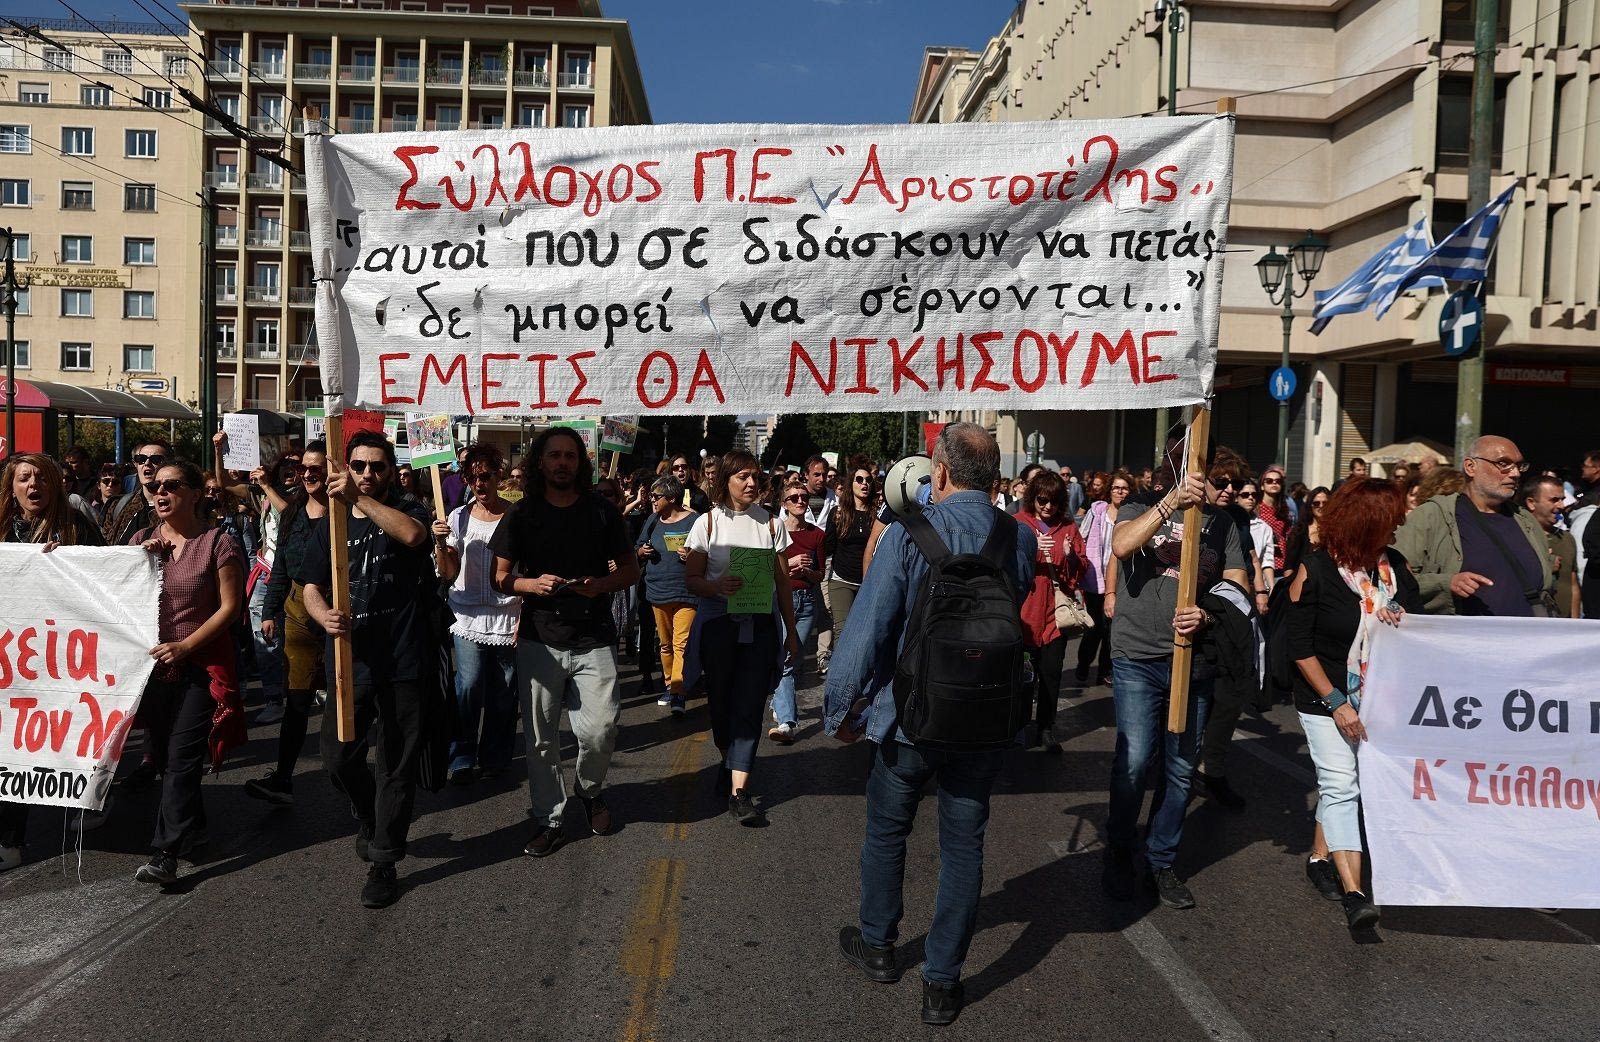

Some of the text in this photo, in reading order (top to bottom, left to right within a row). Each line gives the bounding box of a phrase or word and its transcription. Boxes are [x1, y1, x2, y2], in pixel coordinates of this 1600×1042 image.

[394, 142, 661, 217] Σύλλογος
[694, 148, 796, 204] Π.Ε
[526, 229, 619, 268] που
[638, 227, 709, 270] σε
[743, 214, 1009, 264] διδάσκουν
[1036, 225, 1090, 258] να
[1109, 221, 1216, 262] πετάς
[417, 281, 471, 339] δε
[504, 287, 673, 349] μπορεί
[740, 295, 805, 327] να
[379, 329, 1177, 415] ΕΜΕΙΣ ΘΑ ΝΙΚΗΣΟΥΜΕ
[1409, 686, 1482, 729] Δε
[1503, 689, 1568, 733] θα
